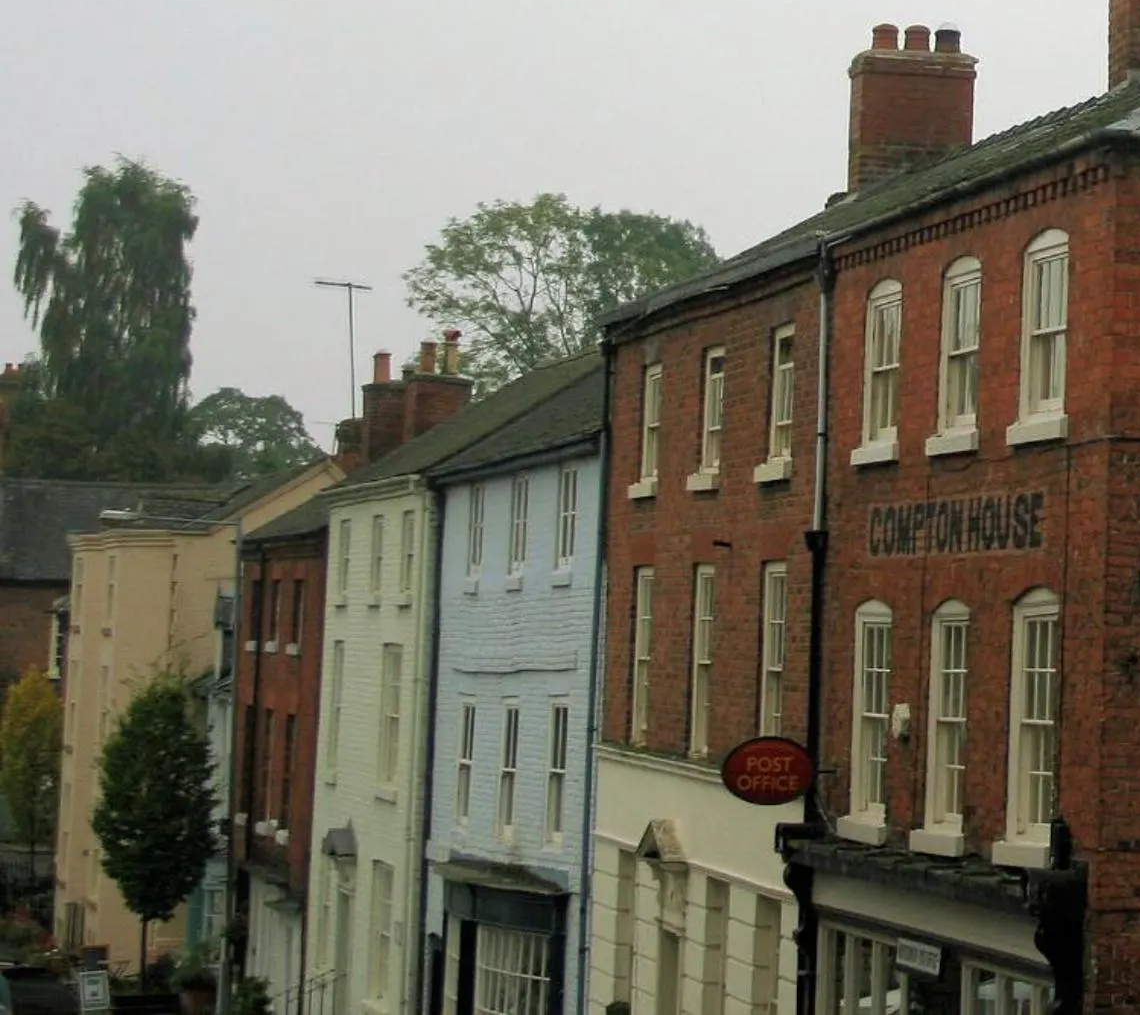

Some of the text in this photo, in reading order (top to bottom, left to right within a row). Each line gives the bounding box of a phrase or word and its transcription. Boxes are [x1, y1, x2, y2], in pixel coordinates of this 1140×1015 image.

[869, 492, 1045, 557] COMPTON HOUSE
[747, 757, 793, 772] POST
[737, 775, 799, 791] OFFICE
